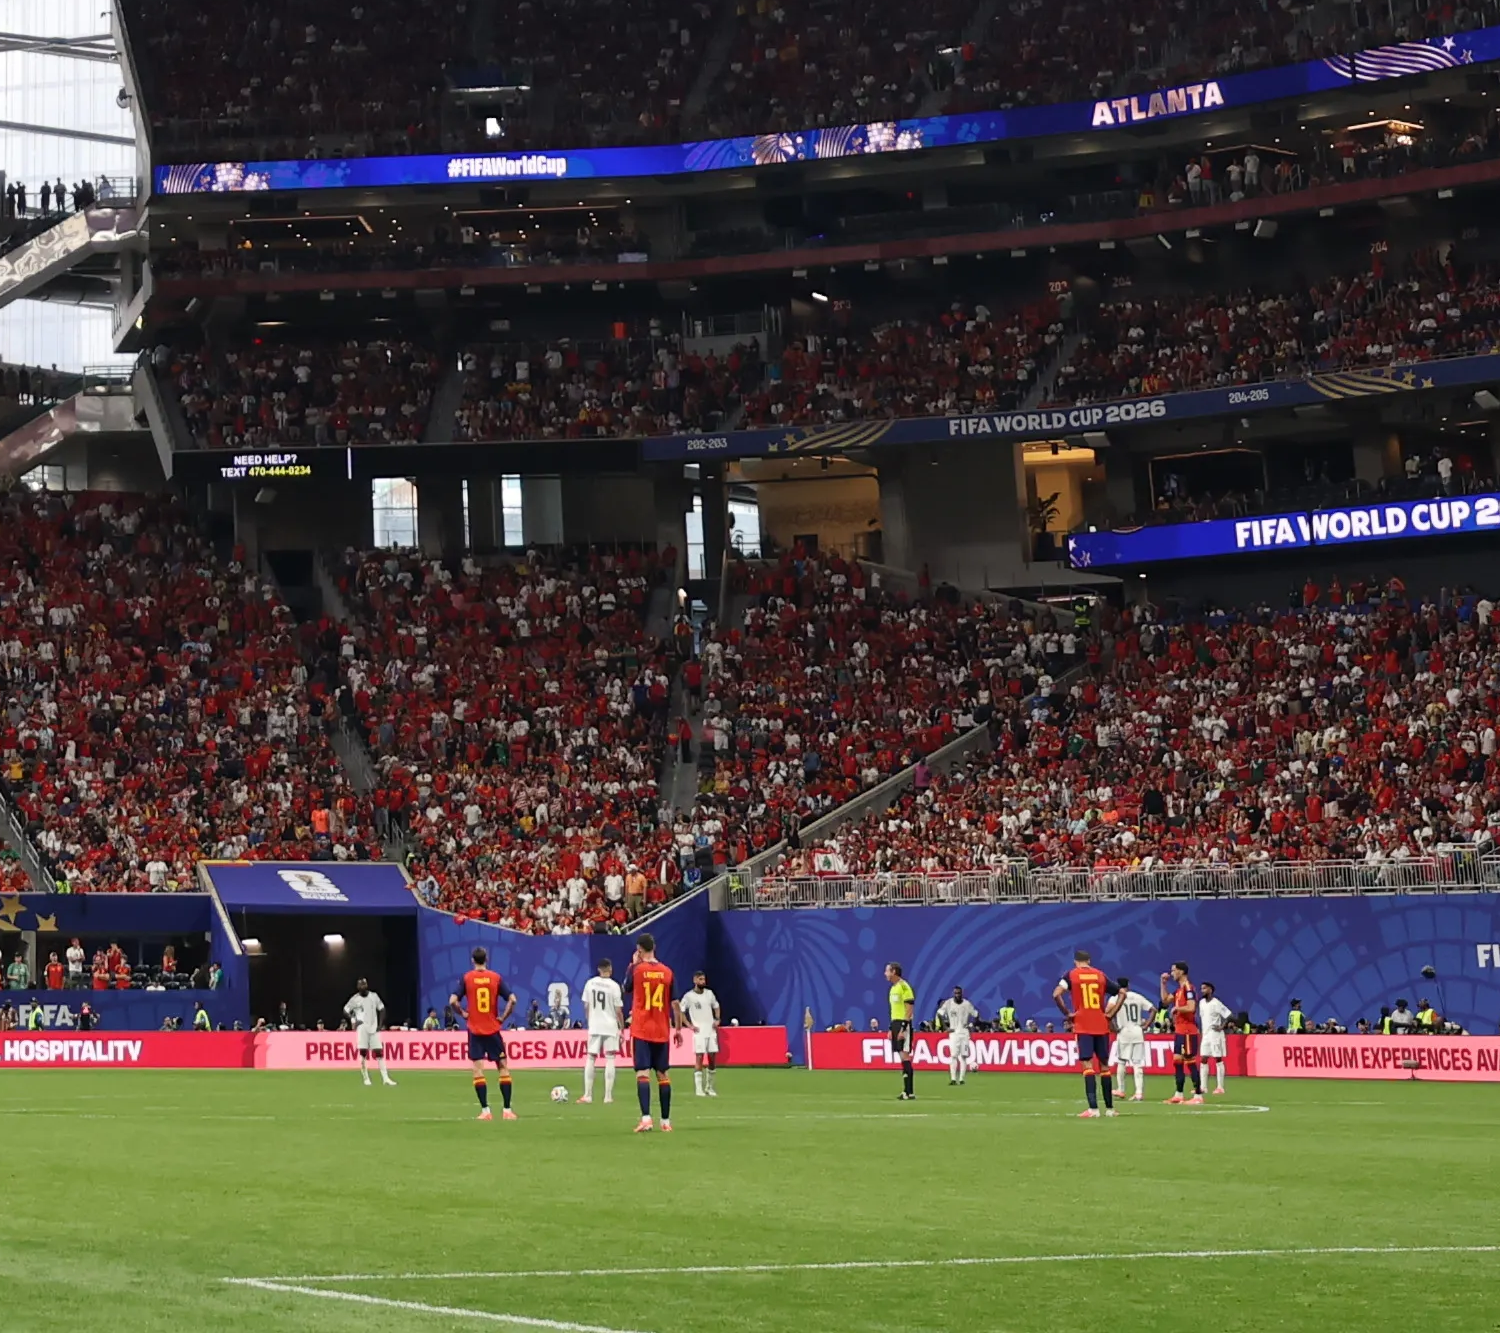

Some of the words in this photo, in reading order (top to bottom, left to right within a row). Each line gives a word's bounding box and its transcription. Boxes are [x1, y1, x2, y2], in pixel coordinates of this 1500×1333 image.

[1092, 82, 1224, 127] ATLANTA
[448, 155, 566, 177] #FIFAWorldCup
[1229, 389, 1269, 404] 204-205
[949, 417, 992, 436] FIFA
[996, 411, 1066, 433] WORLD
[1069, 409, 1102, 429] CUP
[1105, 400, 1166, 422] 2026
[234, 455, 262, 465] NEED
[264, 454, 298, 464] HELP?
[221, 467, 246, 477] TEXT
[1236, 516, 1296, 547] FIFA
[1300, 508, 1406, 542] WORLD
[1411, 499, 1469, 531] CUP
[476, 987, 491, 1014] 8
[592, 989, 606, 1009] 19
[643, 982, 664, 1012] 14
[1080, 983, 1100, 1009] 16
[19, 1005, 73, 1026] FFA
[1125, 1004, 1138, 1023] 10
[5, 1041, 142, 1062] HOSPITALITY
[306, 1042, 403, 1061] PREMM
[409, 1041, 547, 1061] EXPERCES
[1283, 1046, 1356, 1069] PREMIUM
[1364, 1047, 1473, 1071] EXPERIENCES
